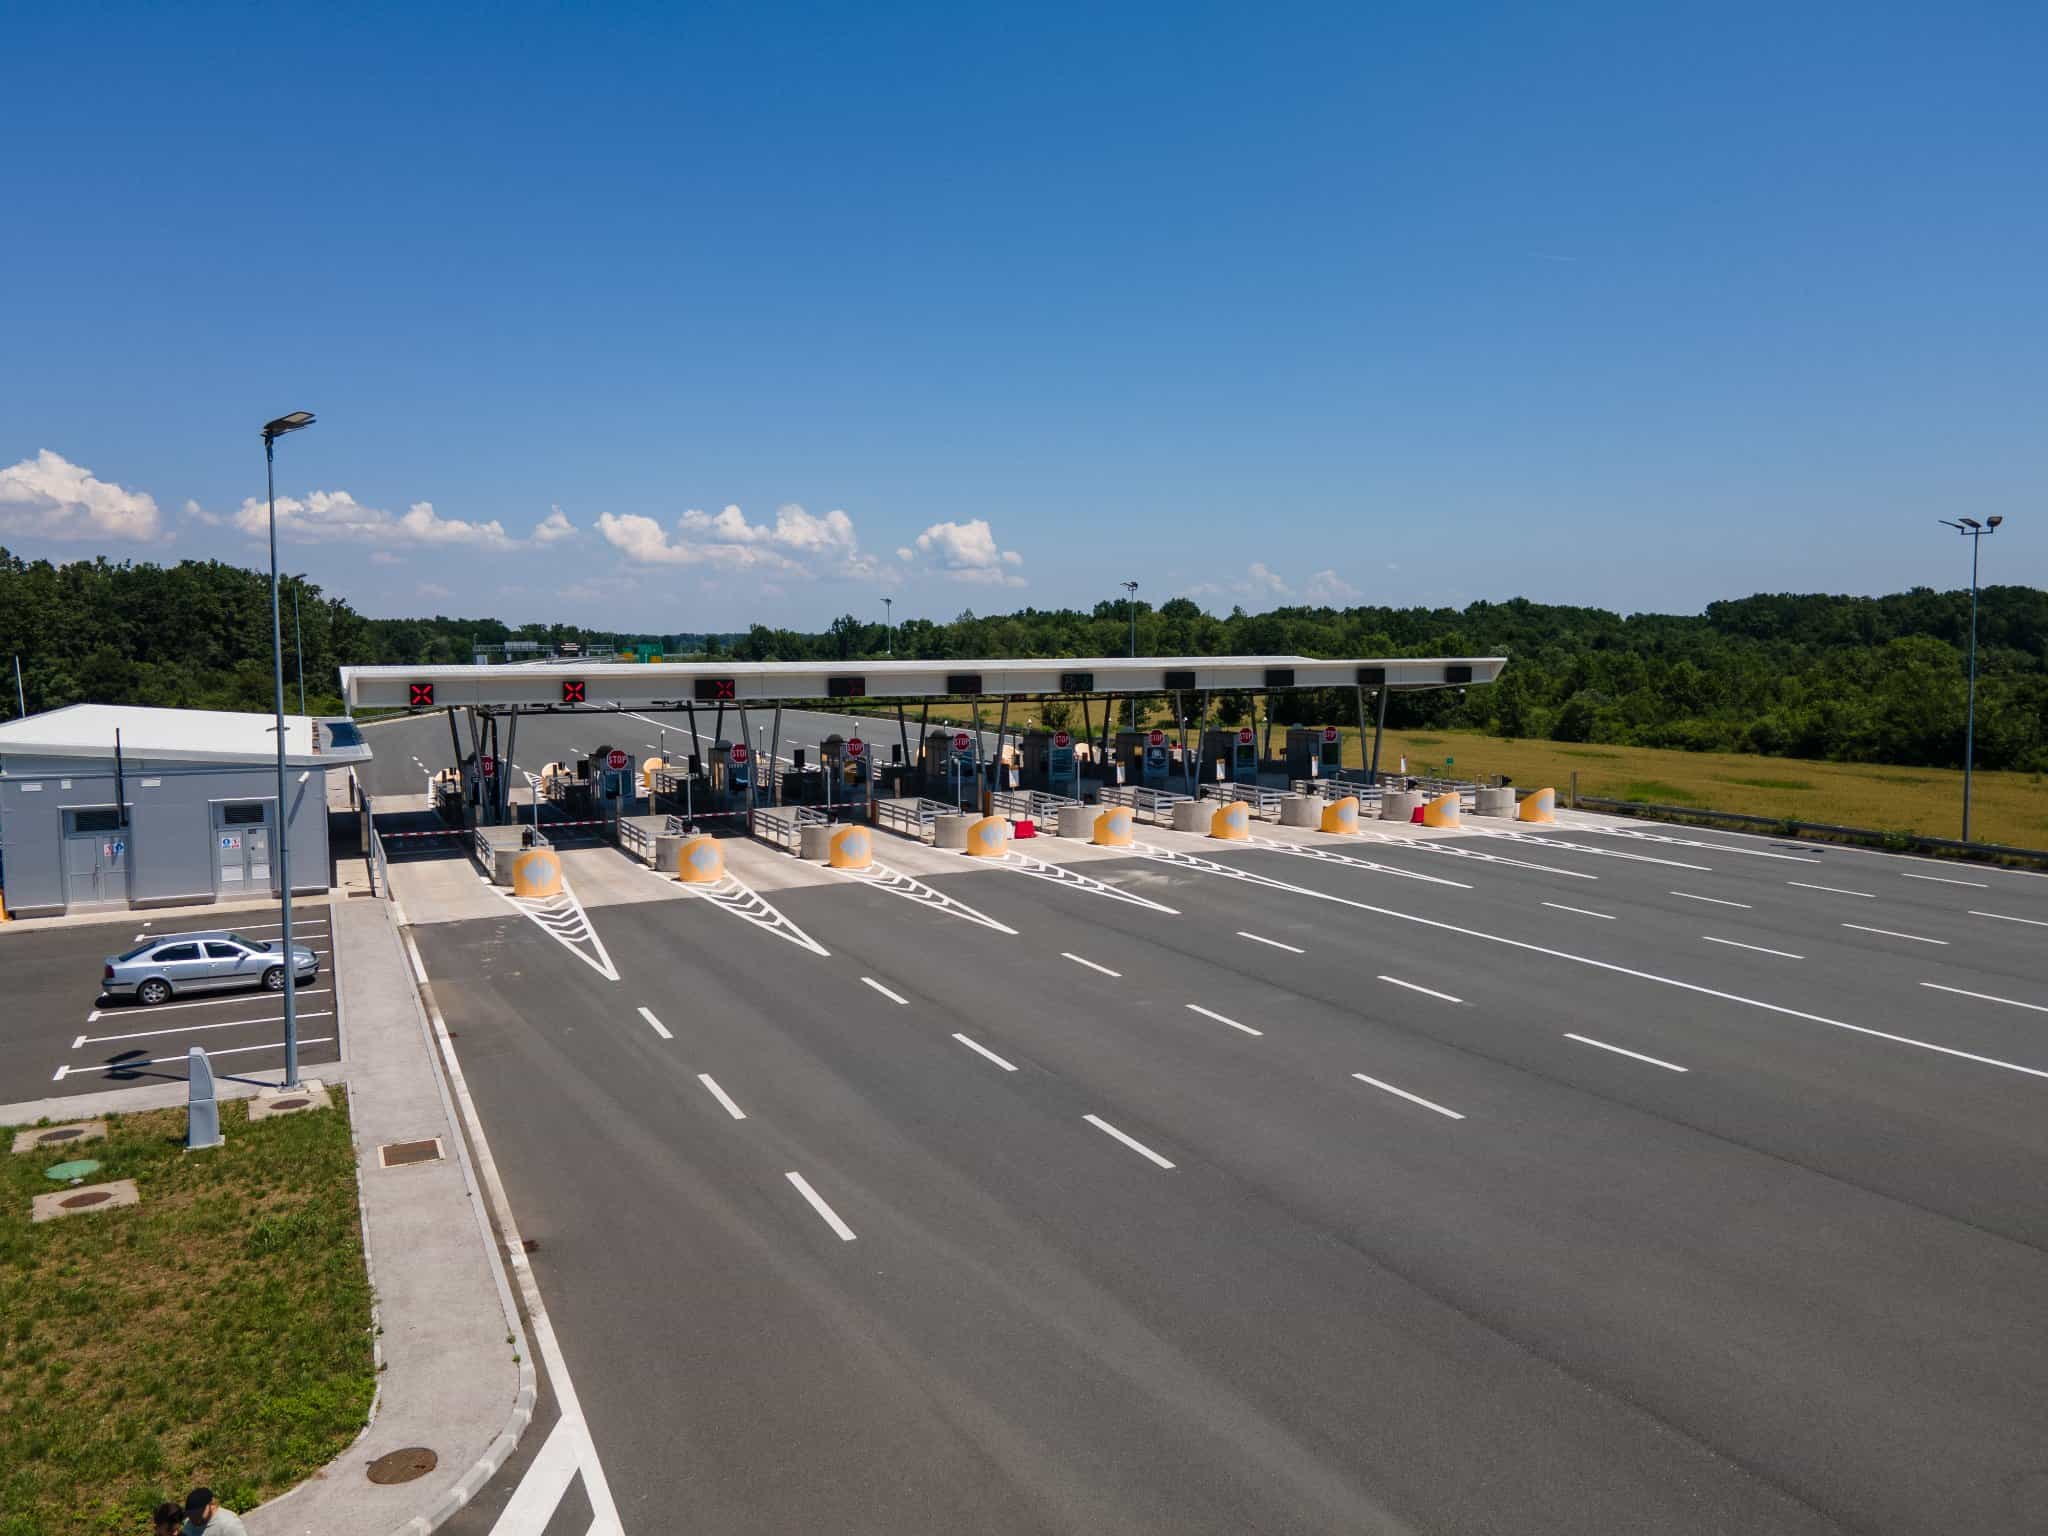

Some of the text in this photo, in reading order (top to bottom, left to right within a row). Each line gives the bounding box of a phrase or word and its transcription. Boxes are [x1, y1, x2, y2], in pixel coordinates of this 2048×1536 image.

[954, 738, 970, 746] STOP
[1056, 735, 1069, 743] STOP
[848, 743, 864, 751] STOP
[608, 755, 626, 764] STOP
